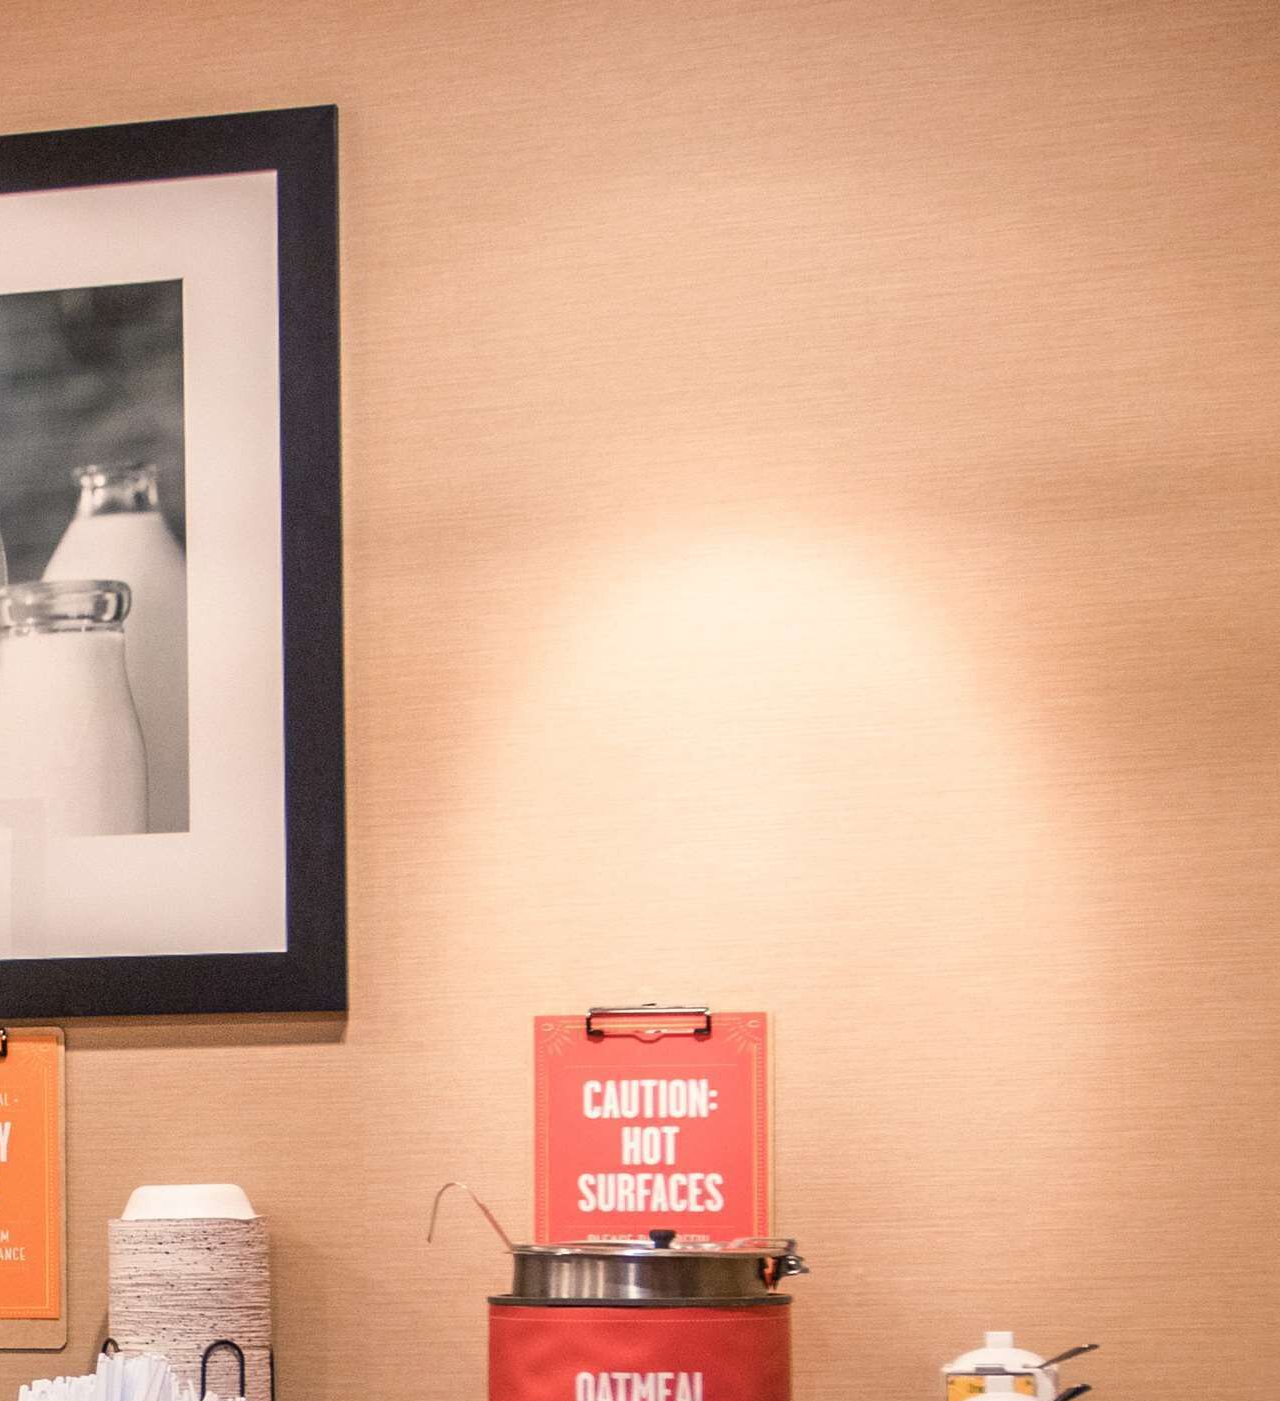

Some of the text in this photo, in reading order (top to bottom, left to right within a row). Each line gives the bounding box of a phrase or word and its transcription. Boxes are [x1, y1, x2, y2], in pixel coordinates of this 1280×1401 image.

[583, 1079, 718, 1118] CAUTION:
[622, 1126, 680, 1166] HOT
[577, 1173, 724, 1212] SURFACES
